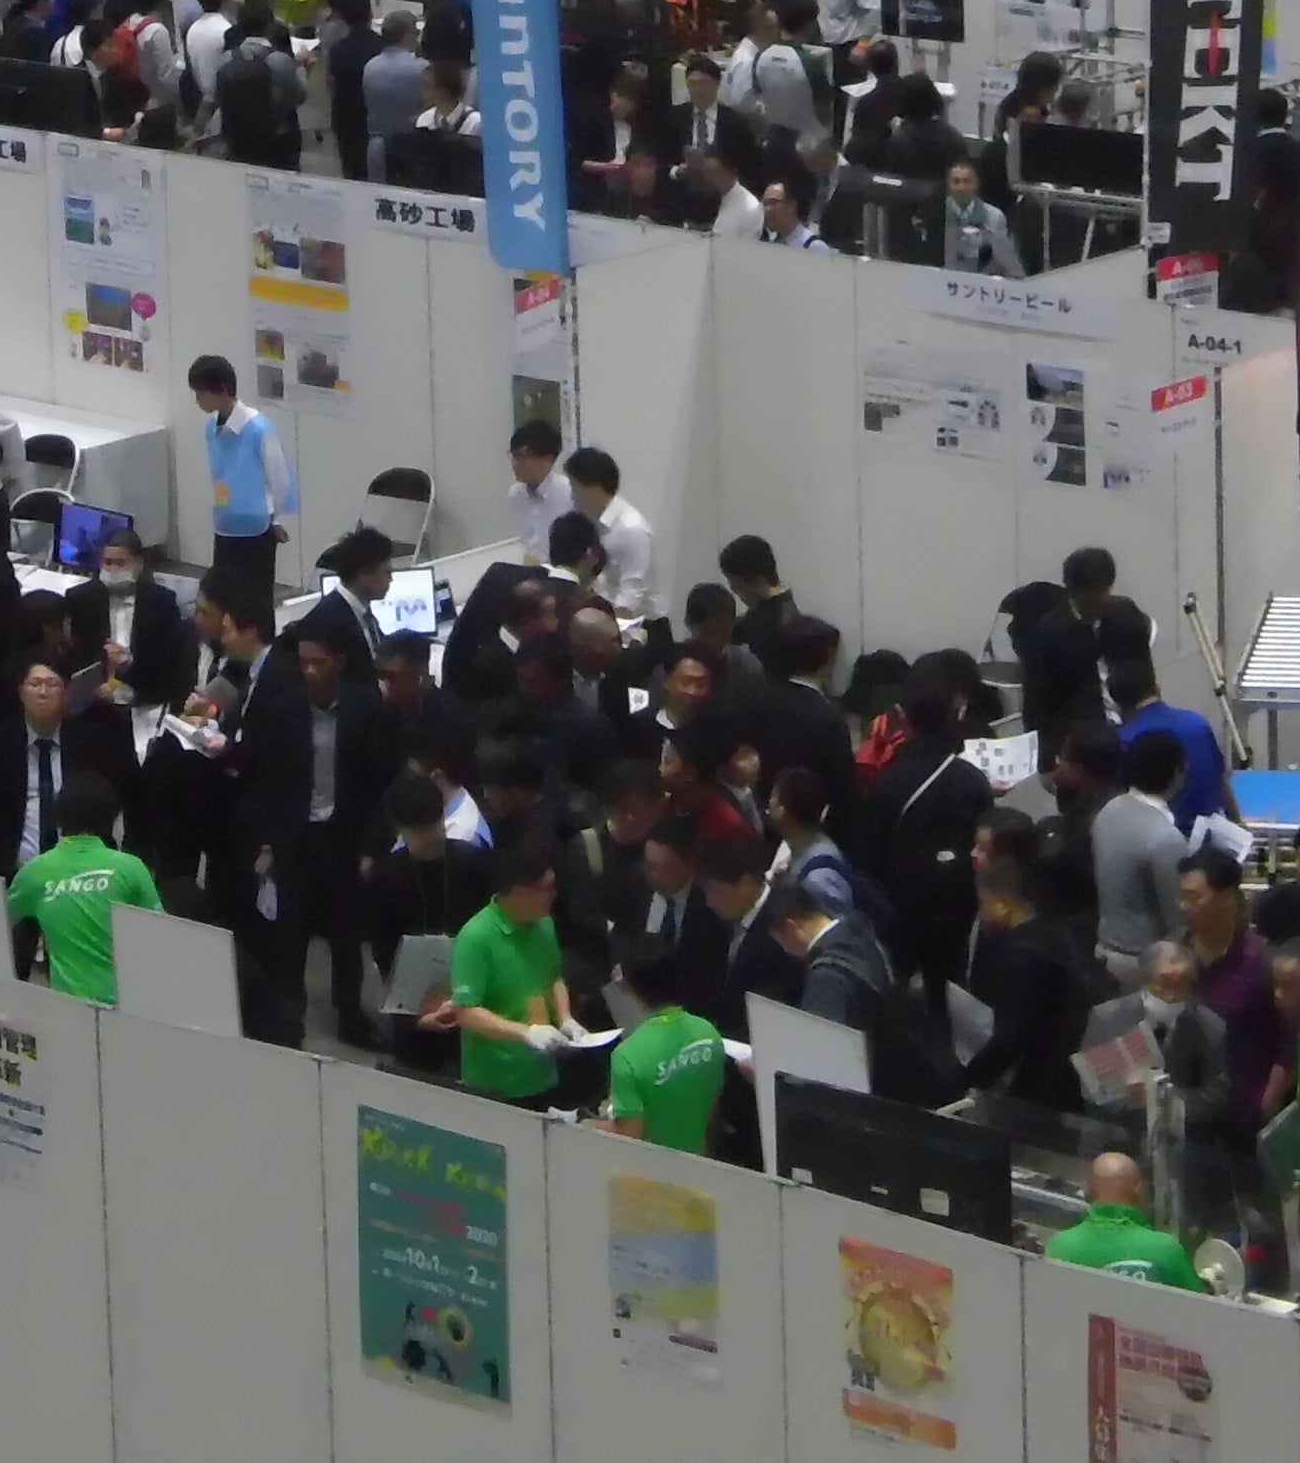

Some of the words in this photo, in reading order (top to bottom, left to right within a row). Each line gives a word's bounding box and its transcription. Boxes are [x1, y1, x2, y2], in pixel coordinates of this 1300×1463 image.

[374, 198, 476, 233] 高砂工場
[945, 281, 1073, 314] サントリービール
[1187, 334, 1242, 355] A-04-1
[43, 869, 114, 902] SANGO
[655, 1039, 713, 1086] SANGO
